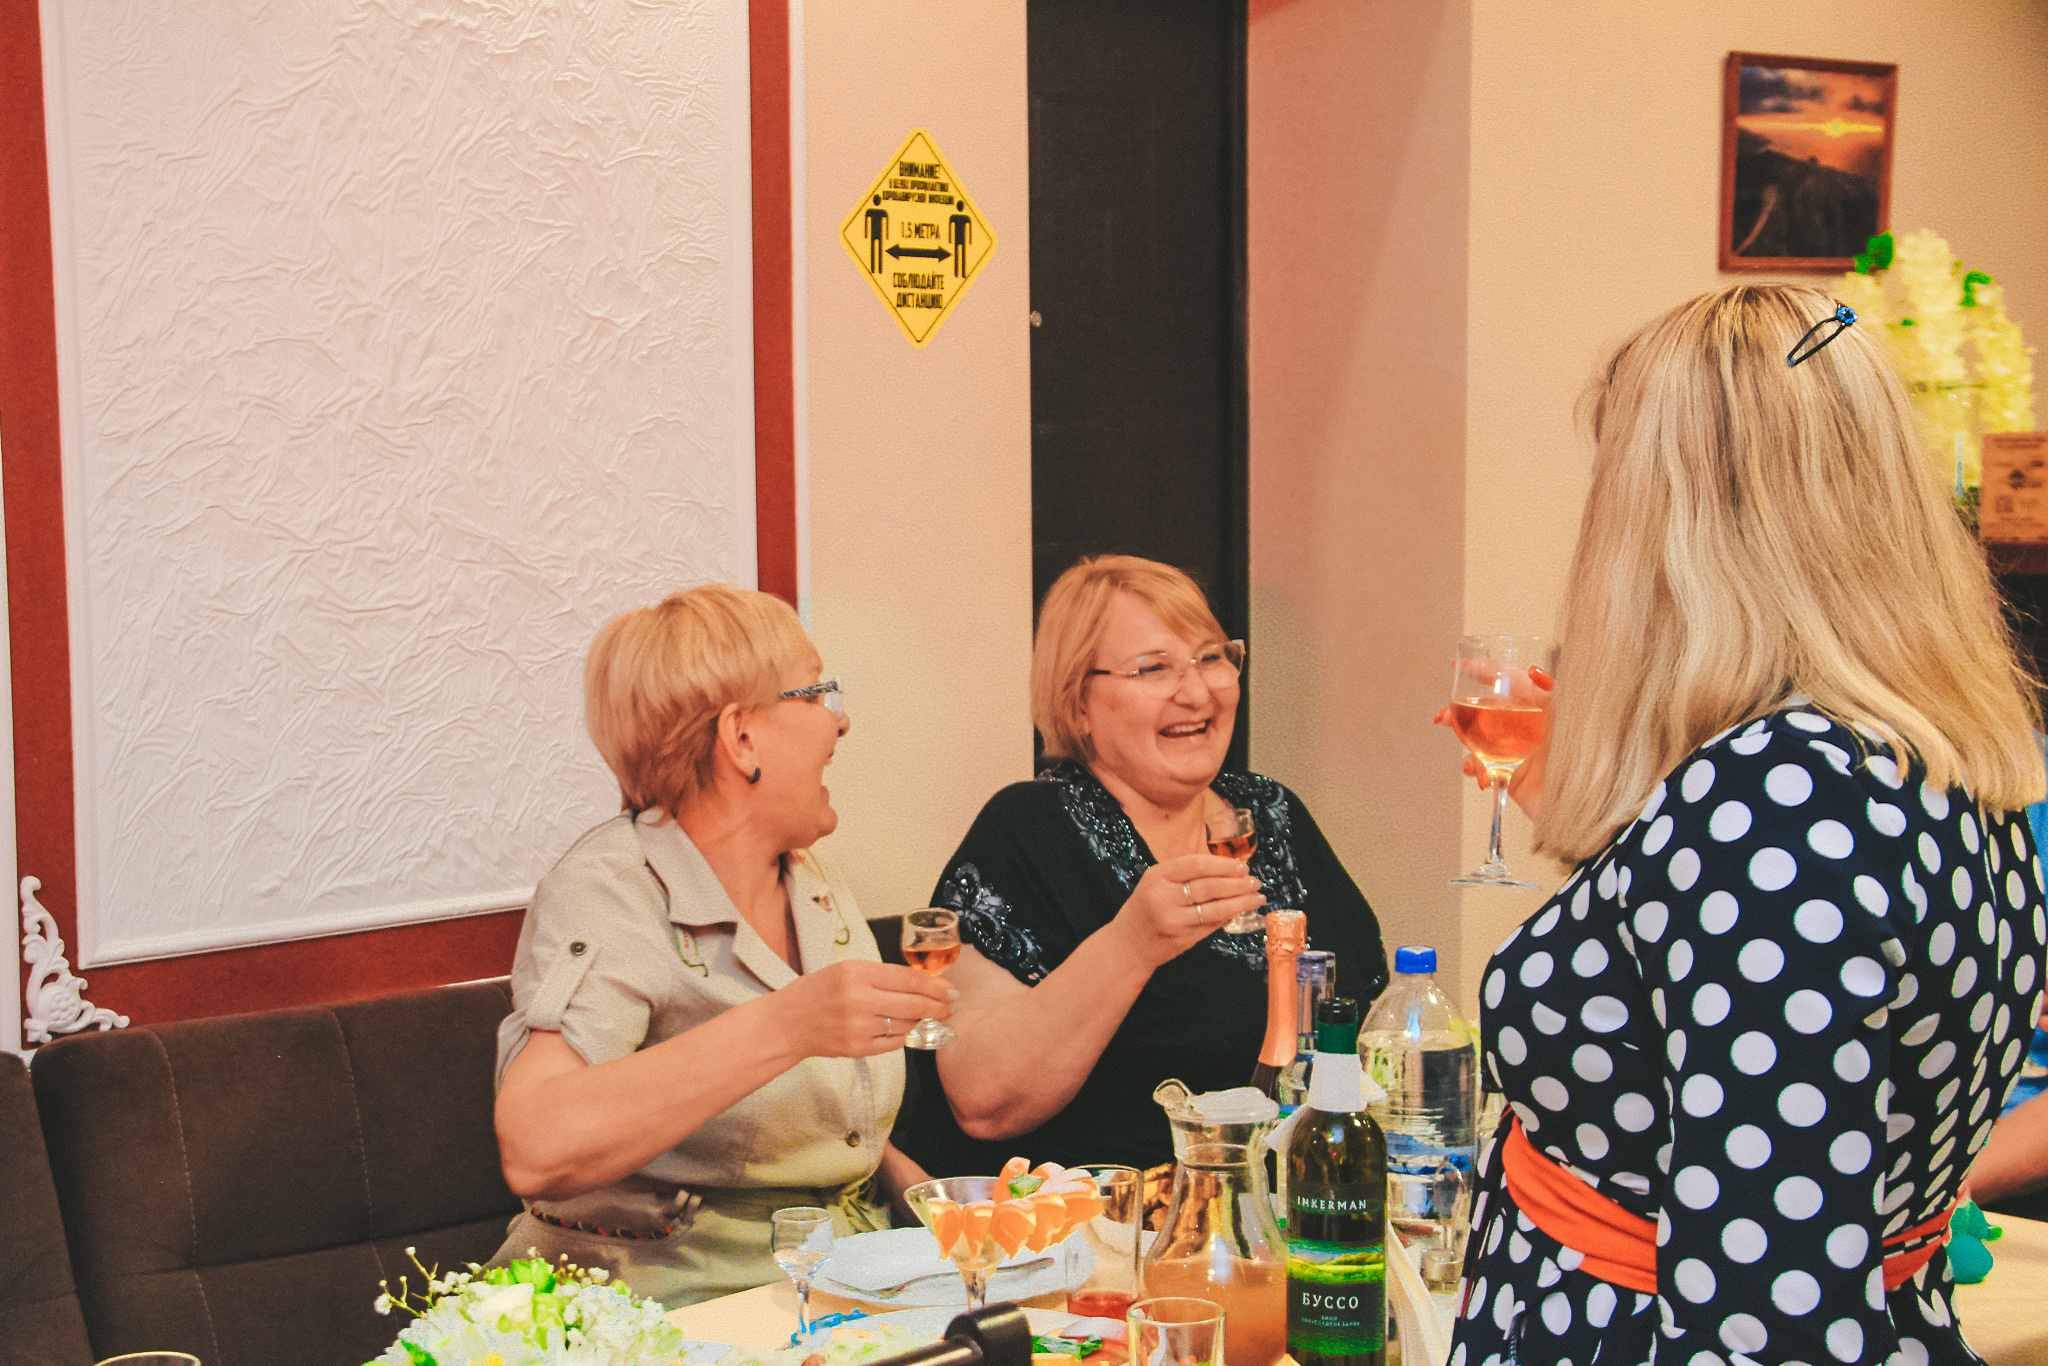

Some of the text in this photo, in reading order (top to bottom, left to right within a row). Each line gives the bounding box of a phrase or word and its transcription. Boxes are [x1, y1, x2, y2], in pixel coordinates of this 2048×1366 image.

[914, 222, 941, 239] МЕТРА
[893, 271, 944, 290] СОБЛЮДАЙТЕ
[896, 292, 943, 309] ДИСТАНЦИЮ
[1297, 1195, 1367, 1210] INKERMAN
[1302, 1292, 1359, 1309] БУССО
